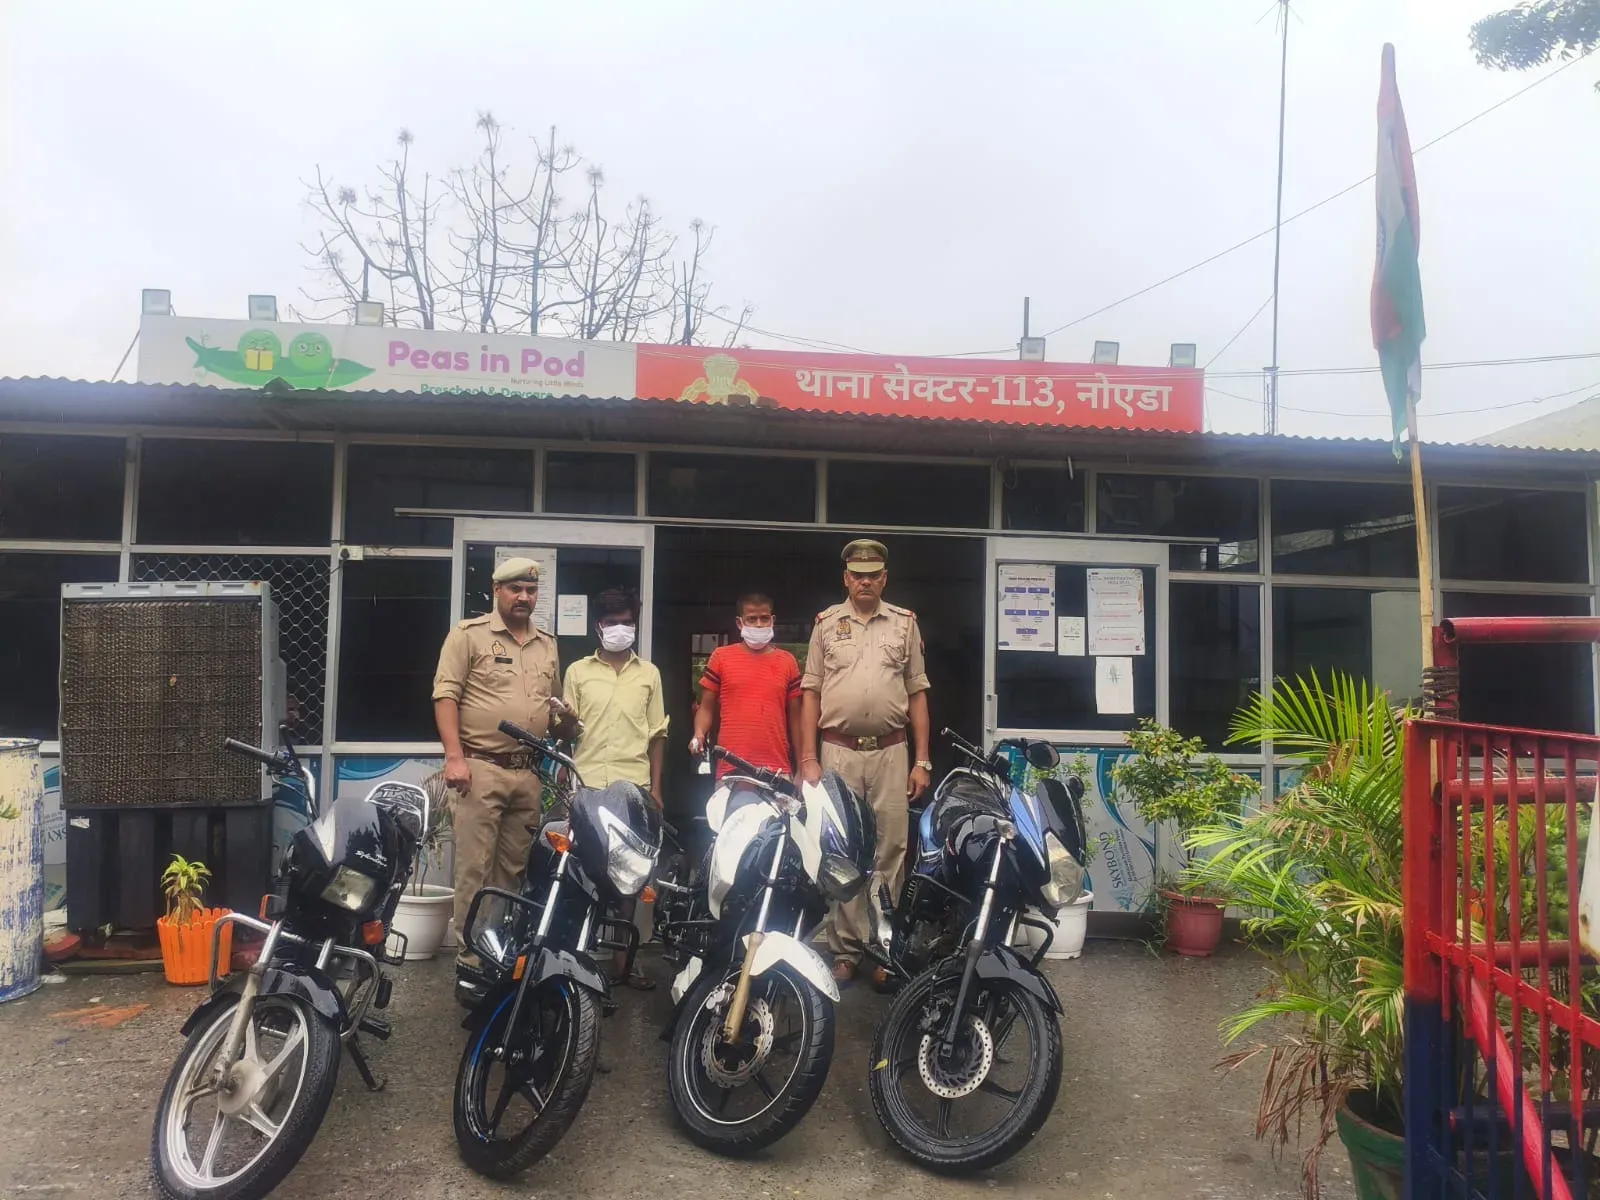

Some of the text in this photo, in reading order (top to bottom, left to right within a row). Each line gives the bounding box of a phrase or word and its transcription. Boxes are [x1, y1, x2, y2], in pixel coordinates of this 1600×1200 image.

[388, 340, 585, 378] Peas in Pod
[795, 362, 1173, 418] थाना सेक्टर-113, नोएडा
